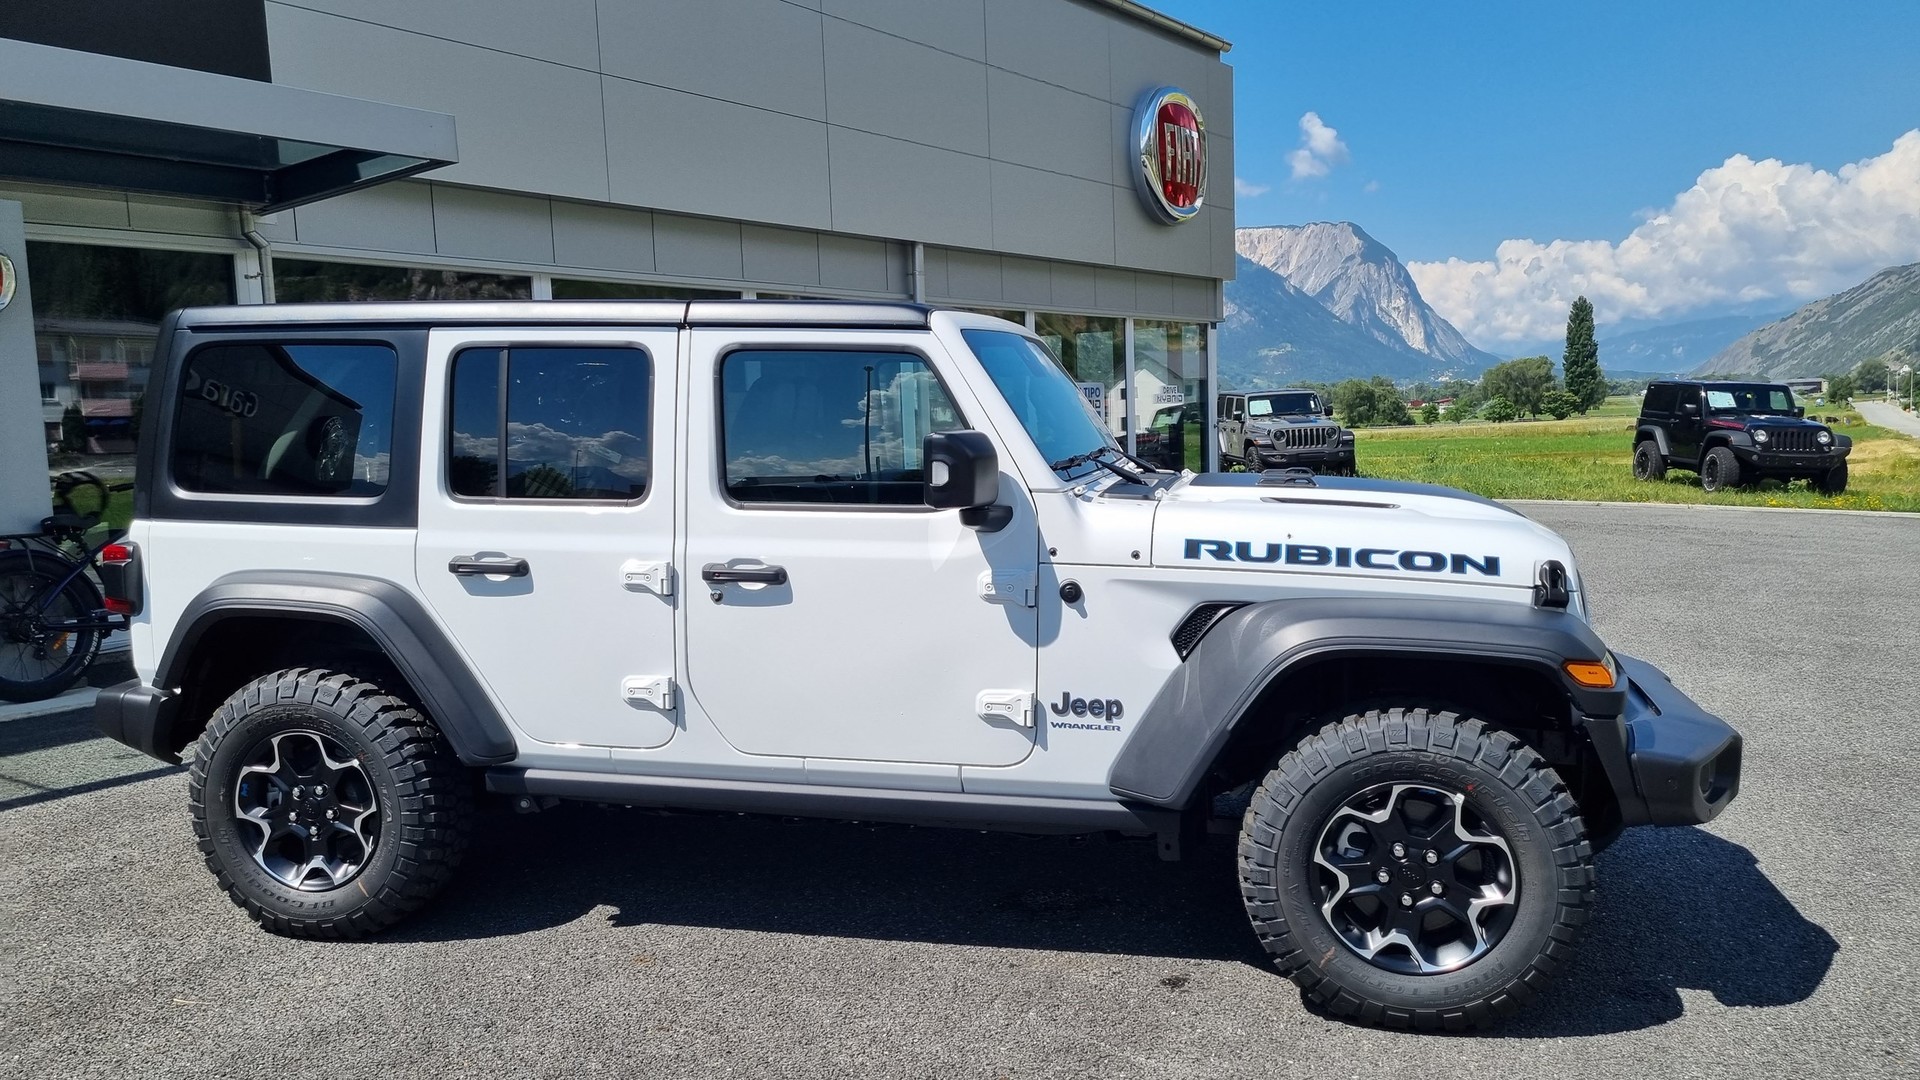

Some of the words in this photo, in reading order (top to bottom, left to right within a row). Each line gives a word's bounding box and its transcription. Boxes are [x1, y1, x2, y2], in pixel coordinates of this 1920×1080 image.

[1164, 122, 1202, 188] FIAT
[1083, 386, 1101, 398] TIPO
[1184, 538, 1501, 577] RUBICON
[1051, 691, 1124, 722] Jeep
[1050, 721, 1122, 732] WRANGLER
